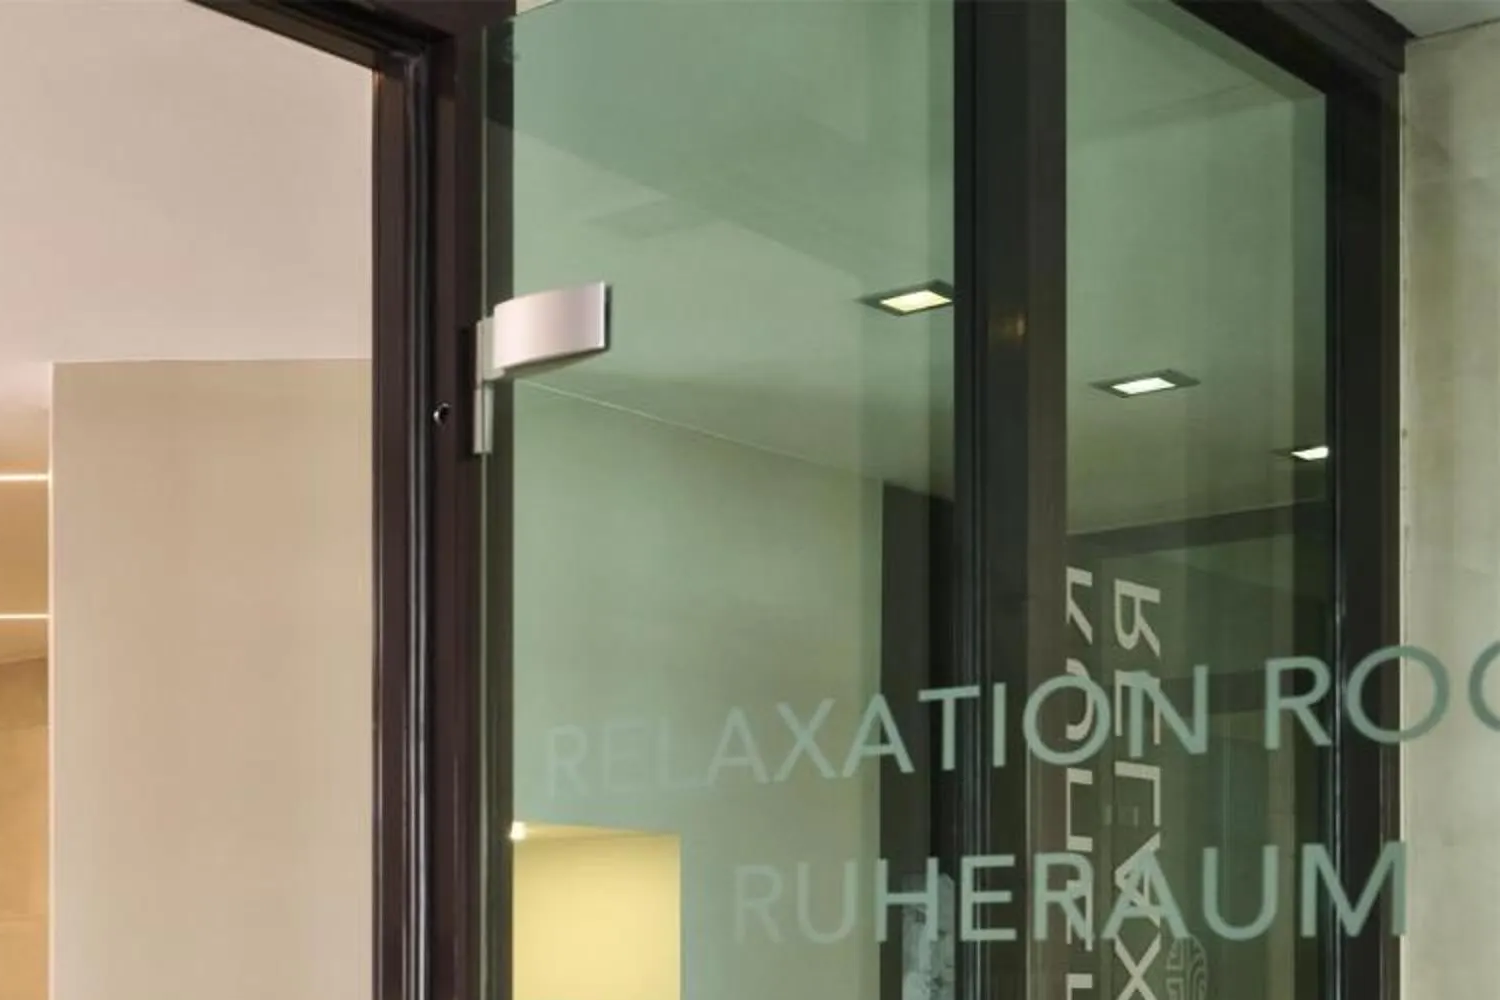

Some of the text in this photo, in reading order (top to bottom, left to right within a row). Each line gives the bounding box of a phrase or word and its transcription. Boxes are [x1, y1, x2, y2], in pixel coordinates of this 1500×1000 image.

[545, 639, 1500, 799] RELAXATION RO
[731, 840, 1407, 944] RUHERAUM
